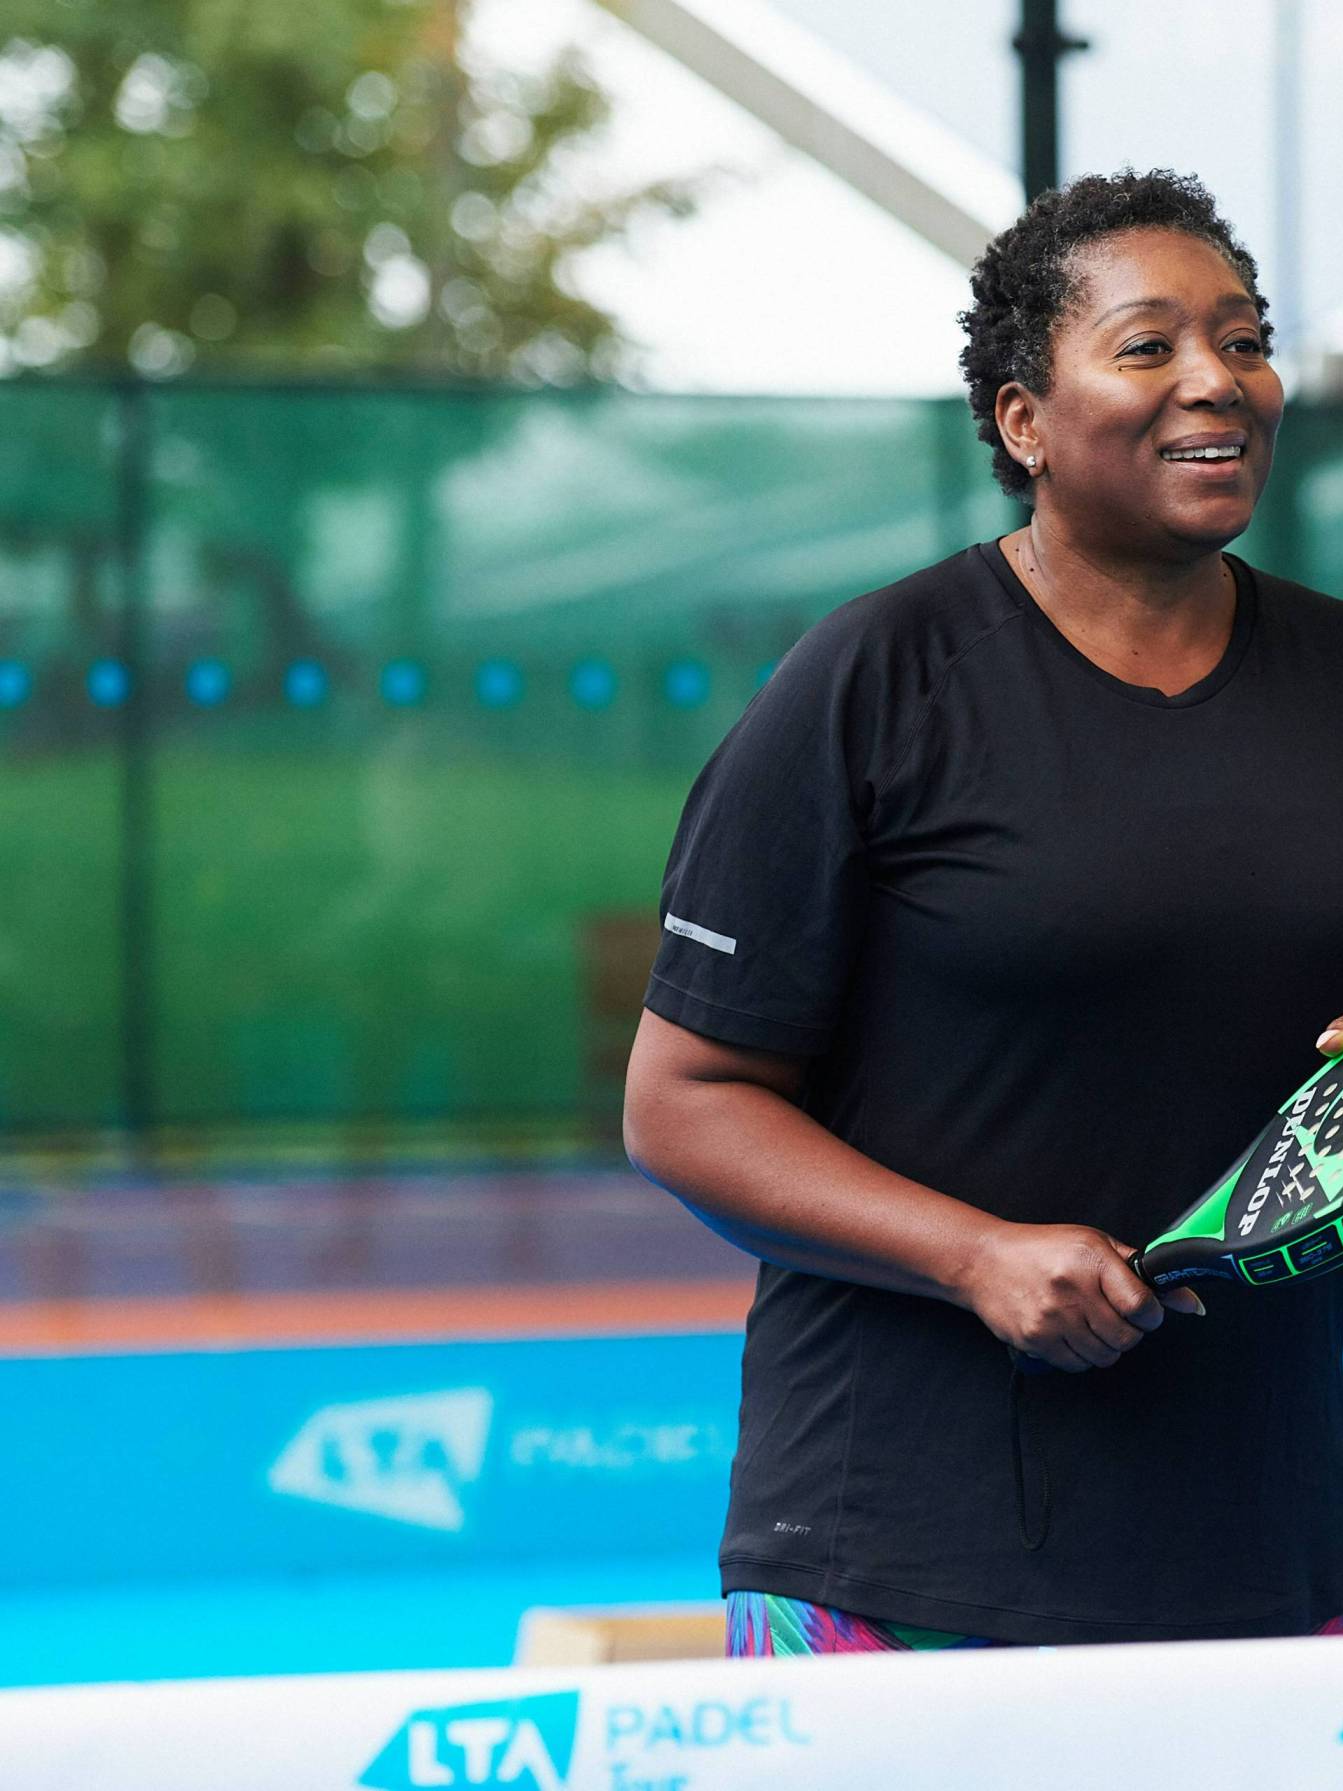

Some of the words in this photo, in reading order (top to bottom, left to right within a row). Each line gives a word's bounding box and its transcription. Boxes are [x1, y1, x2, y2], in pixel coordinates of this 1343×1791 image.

[1238, 1086, 1318, 1237] DUNLOP
[408, 1716, 564, 1788] LTA
[605, 1698, 813, 1750] PADEL
